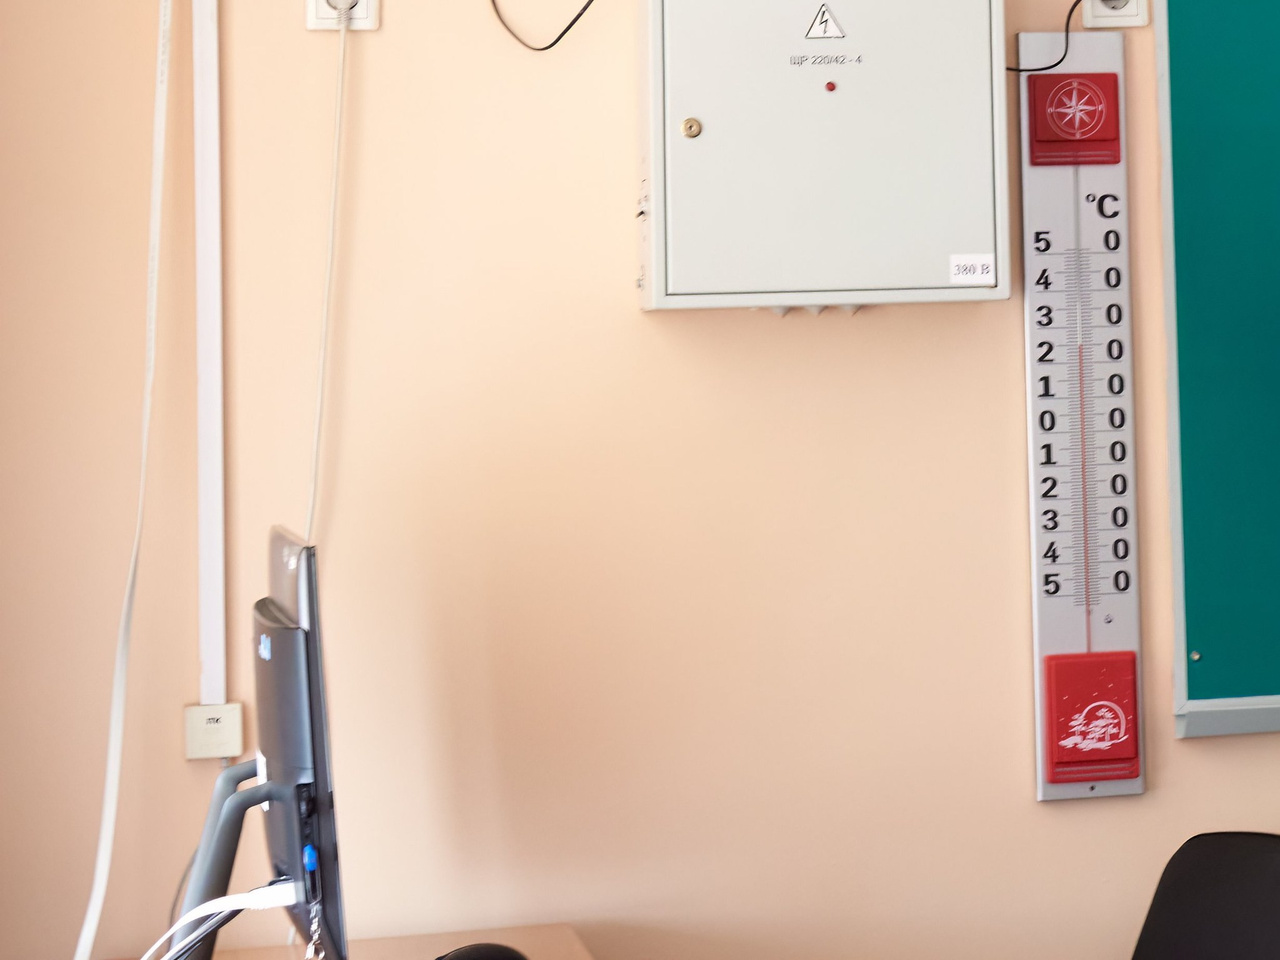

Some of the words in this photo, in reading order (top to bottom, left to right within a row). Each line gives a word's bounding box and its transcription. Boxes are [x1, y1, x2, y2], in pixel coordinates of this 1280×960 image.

[855, 55, 862, 65] 4
[1085, 193, 1120, 219] °C
[1034, 231, 1051, 253] 5
[1104, 229, 1120, 251] 0
[953, 264, 977, 276] 380
[980, 263, 990, 275] В
[1035, 268, 1052, 290] 4
[1104, 267, 1122, 288] 0
[1036, 305, 1053, 327] 3
[1106, 303, 1122, 325] 0
[1037, 341, 1055, 362] 2
[1107, 339, 1123, 360] 0
[1037, 376, 1055, 398] 1
[1108, 373, 1125, 395] 0
[1039, 410, 1056, 432] 0
[1109, 407, 1125, 429] 0
[1040, 443, 1057, 465] 1
[1110, 440, 1127, 462] 0
[1040, 476, 1058, 498] 2
[1111, 473, 1128, 495] 0
[1041, 509, 1058, 531] 3
[1112, 506, 1128, 528] 0
[1042, 541, 1060, 563] 4
[1113, 538, 1129, 560] 0
[1044, 573, 1060, 595] 5
[1114, 570, 1130, 591] 0
